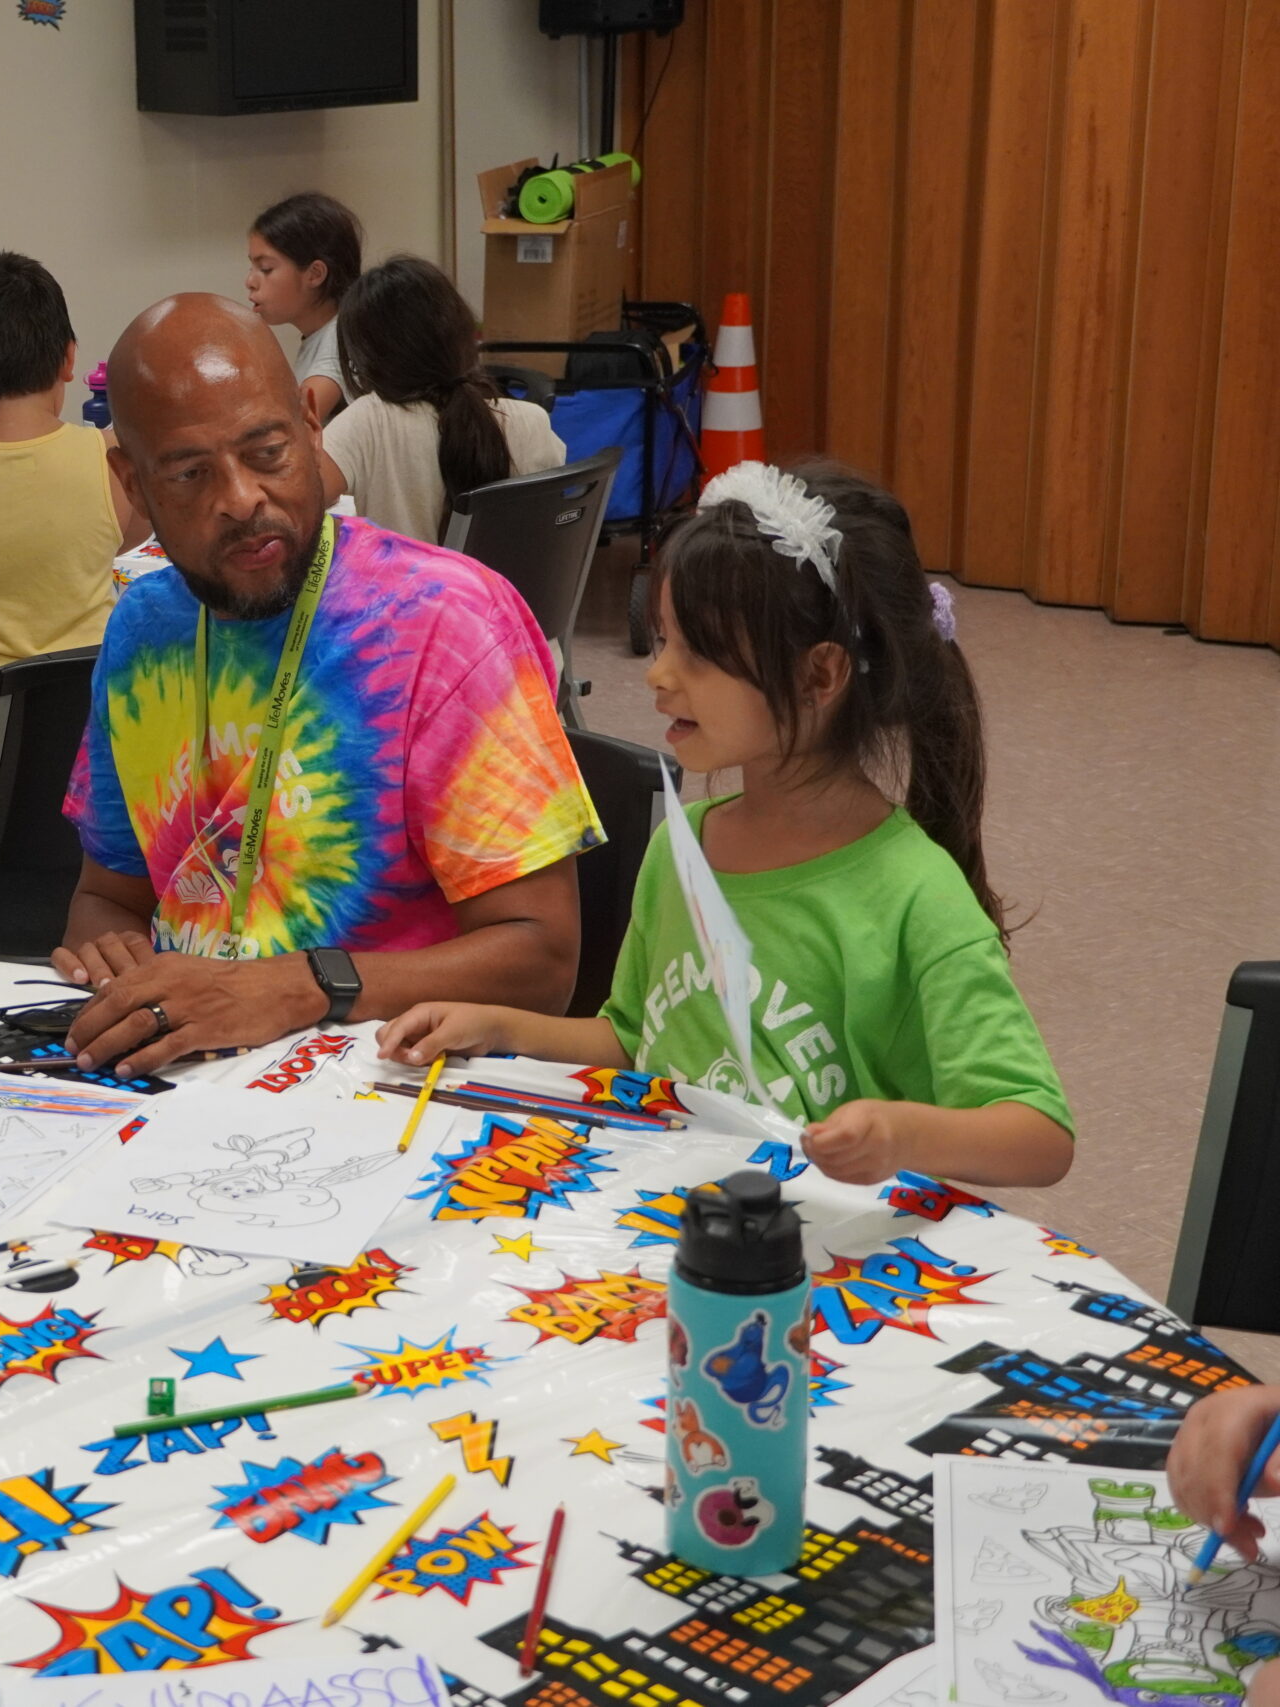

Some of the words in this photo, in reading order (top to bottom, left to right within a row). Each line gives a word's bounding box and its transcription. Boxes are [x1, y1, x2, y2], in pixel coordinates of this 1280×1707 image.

[306, 539, 330, 594] LifeMoves
[267, 671, 292, 729] LifeMoves
[243, 808, 263, 866] LifeMoves
[373, 1519, 516, 1596] POW
